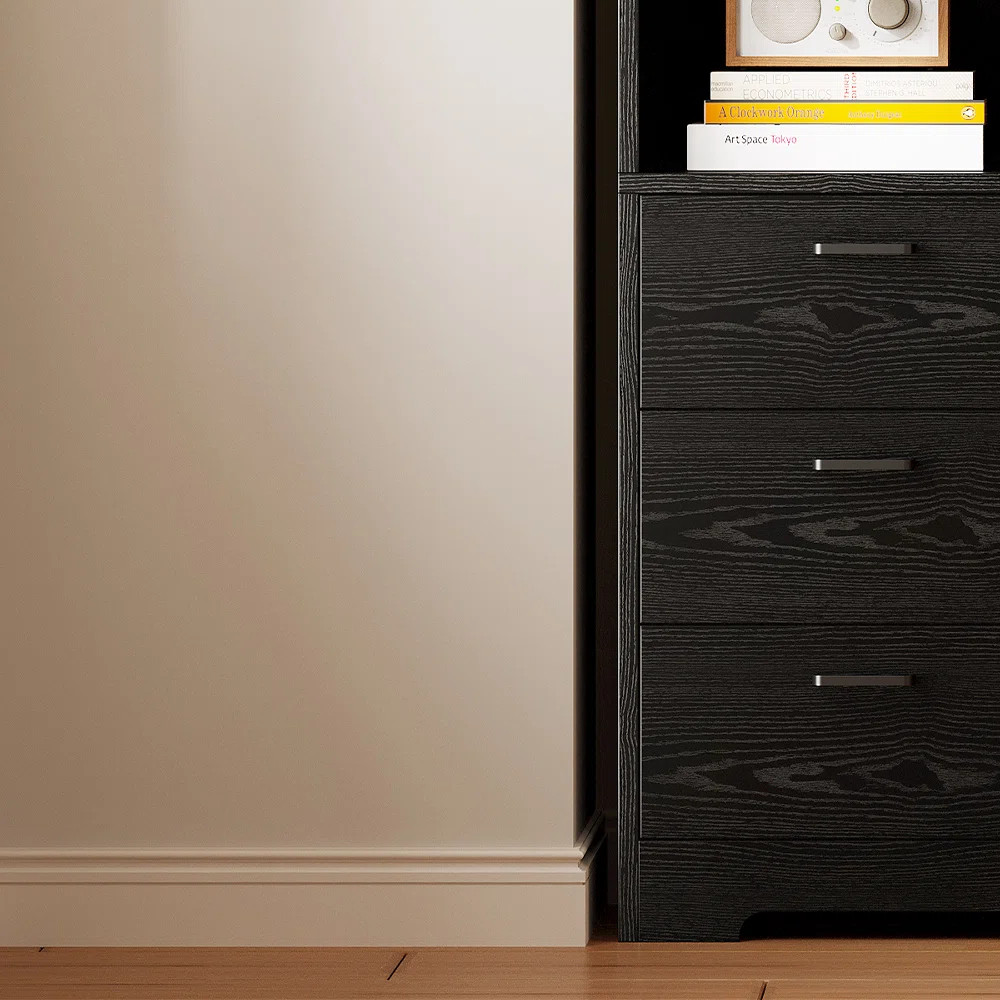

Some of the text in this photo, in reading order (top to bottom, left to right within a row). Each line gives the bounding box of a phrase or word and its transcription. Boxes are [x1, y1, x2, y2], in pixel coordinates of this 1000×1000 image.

[742, 74, 791, 84] APPLIED
[742, 89, 832, 100] ECONOMETRICS
[718, 106, 825, 120] A Clockwork Orange
[724, 135, 798, 146] Art Space Tokyo
